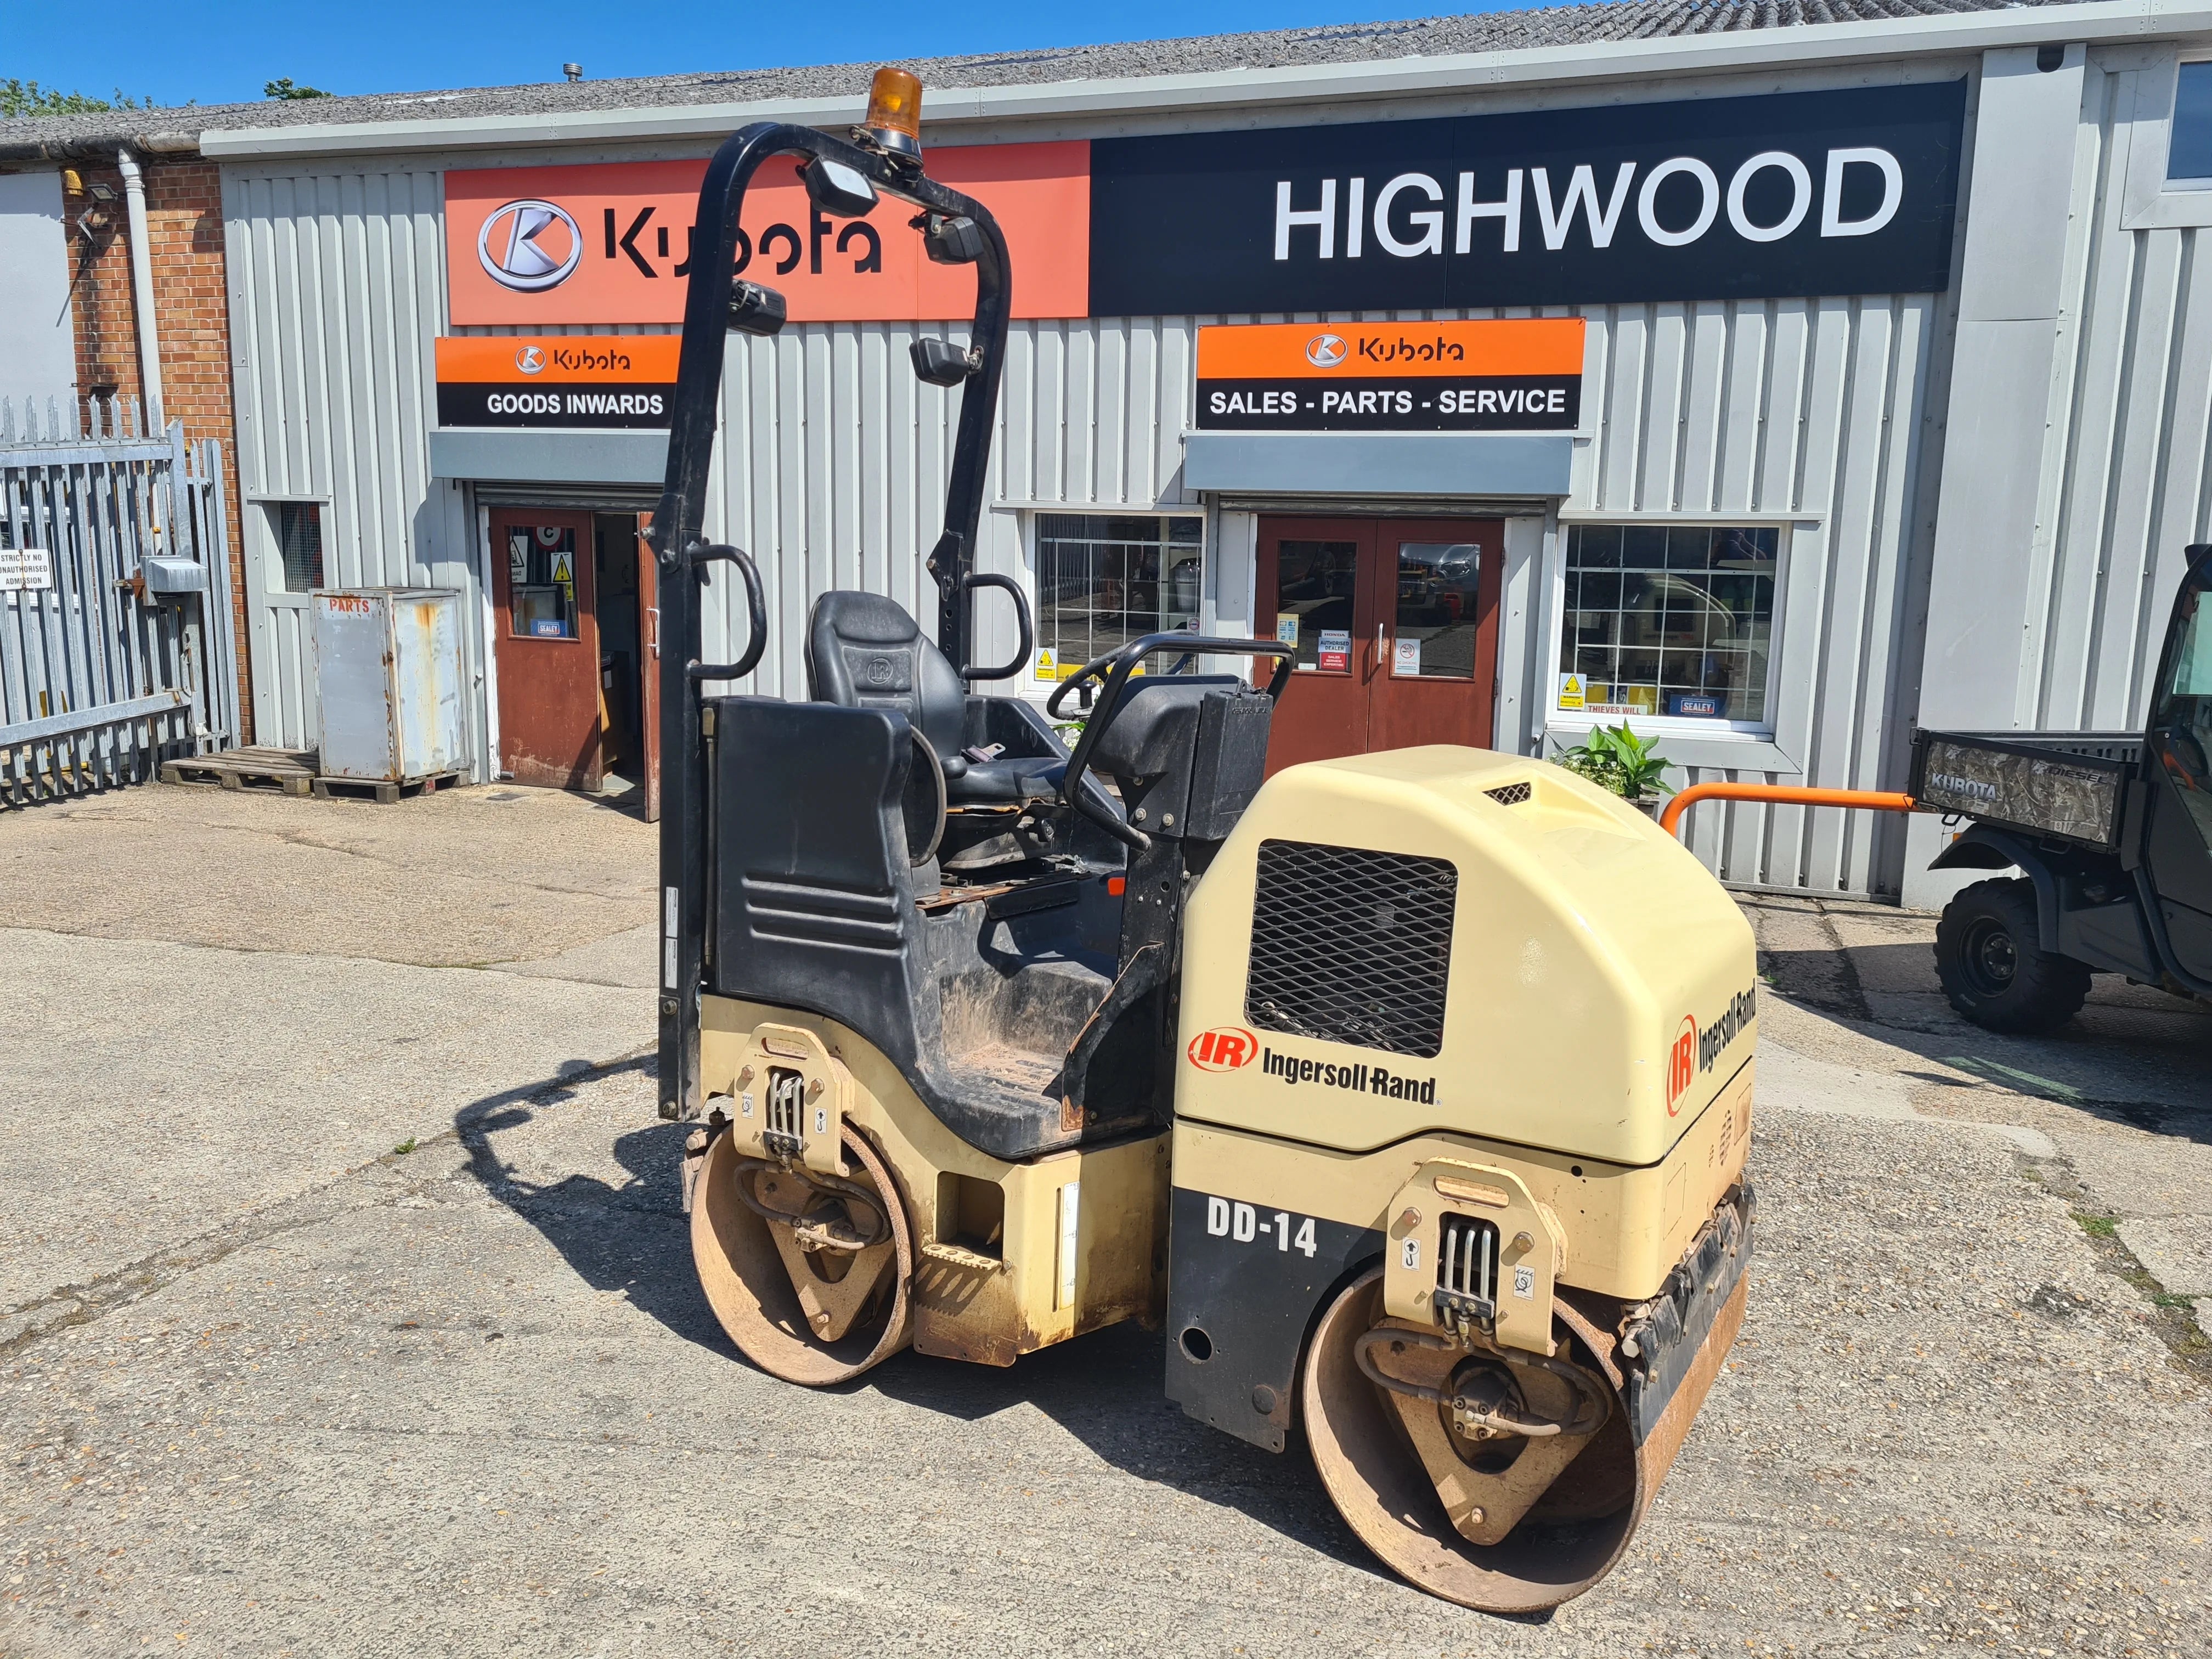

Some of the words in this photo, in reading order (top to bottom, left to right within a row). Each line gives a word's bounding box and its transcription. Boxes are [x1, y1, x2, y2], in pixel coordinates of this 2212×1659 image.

[1274, 146, 1903, 260] HIGHWOOD
[554, 349, 630, 371] Kubota
[1359, 337, 1464, 362] Kubota
[487, 394, 561, 414] GOODS
[567, 394, 663, 415] INWARDS
[1210, 391, 1297, 414] SALES
[1323, 391, 1412, 414] PARTS
[1438, 390, 1565, 414] SERVICE
[6, 577, 42, 585] ADMISSION
[329, 598, 369, 613] PARTS
[540, 625, 558, 633] SEALEY
[1684, 702, 1712, 712] SEALEY
[2047, 766, 2107, 784] DIESEL
[1932, 773, 1996, 802] KUBOTA
[1699, 996, 1736, 1074] Ingersoll
[1198, 1031, 1246, 1068] IR
[1263, 1047, 1368, 1092] Ingersoll
[1207, 1196, 1317, 1258] DD-14
